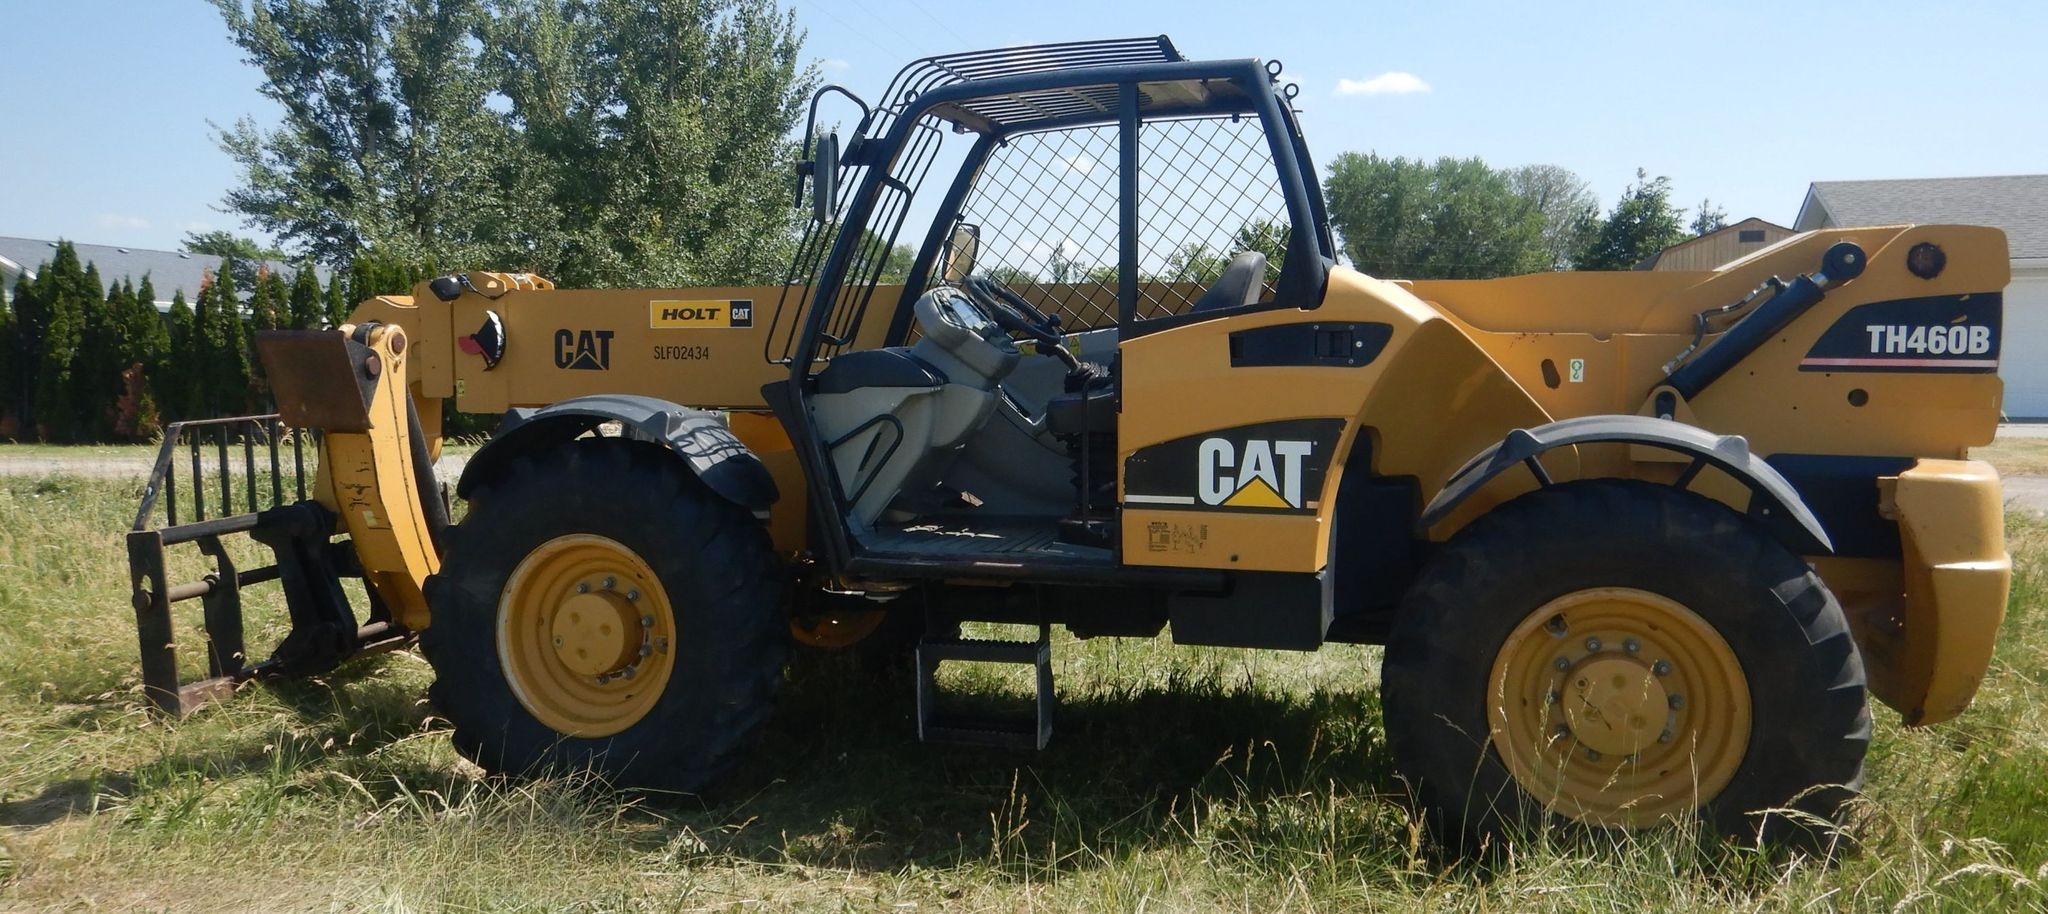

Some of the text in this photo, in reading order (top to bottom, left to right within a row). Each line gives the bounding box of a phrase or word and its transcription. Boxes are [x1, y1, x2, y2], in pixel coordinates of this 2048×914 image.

[661, 308, 750, 321] HOLT CAT
[555, 328, 614, 371] CAT
[653, 346, 709, 361] SLF02434
[1866, 325, 1990, 354] TH460B
[1198, 437, 1312, 509] CAT
